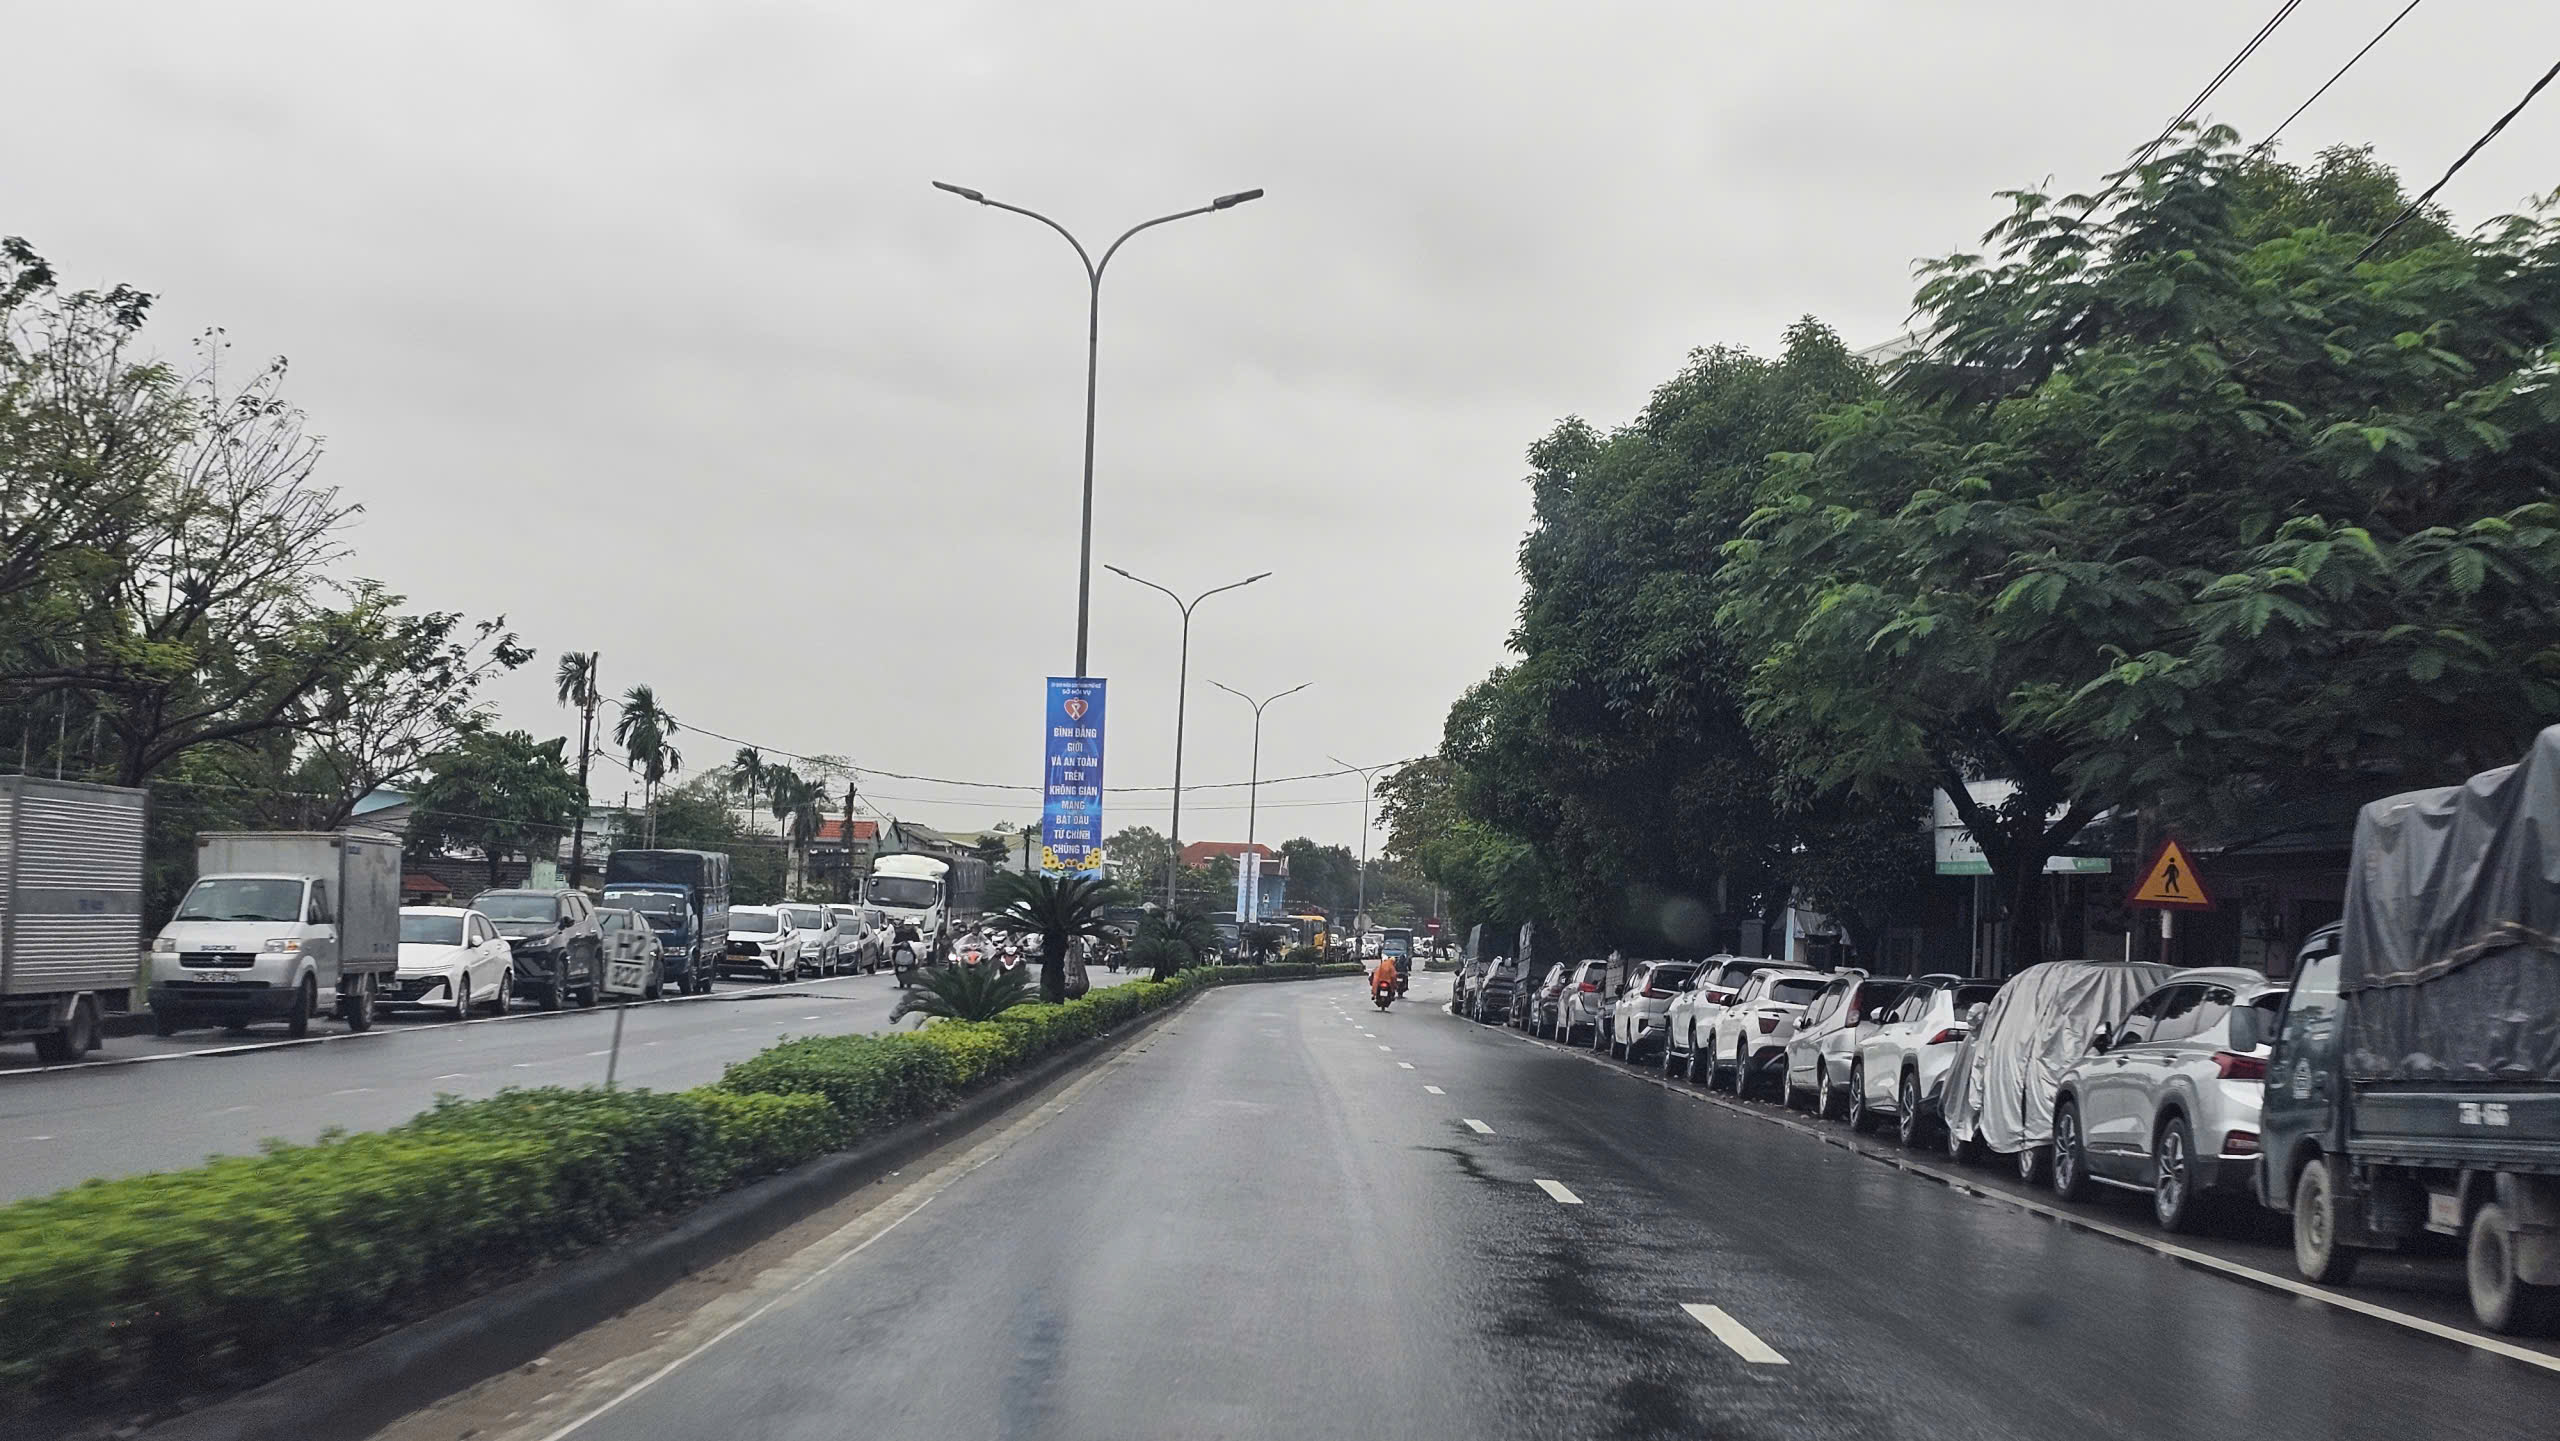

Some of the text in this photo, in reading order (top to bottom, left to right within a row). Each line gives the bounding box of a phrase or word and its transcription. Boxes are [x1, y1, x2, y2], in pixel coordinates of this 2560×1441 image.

[1063, 757, 1075, 766] AN
[1077, 756, 1098, 767] TOÀN
[1078, 786, 1098, 796] GIAN
[1052, 843, 1091, 854] CHÚNG TA
